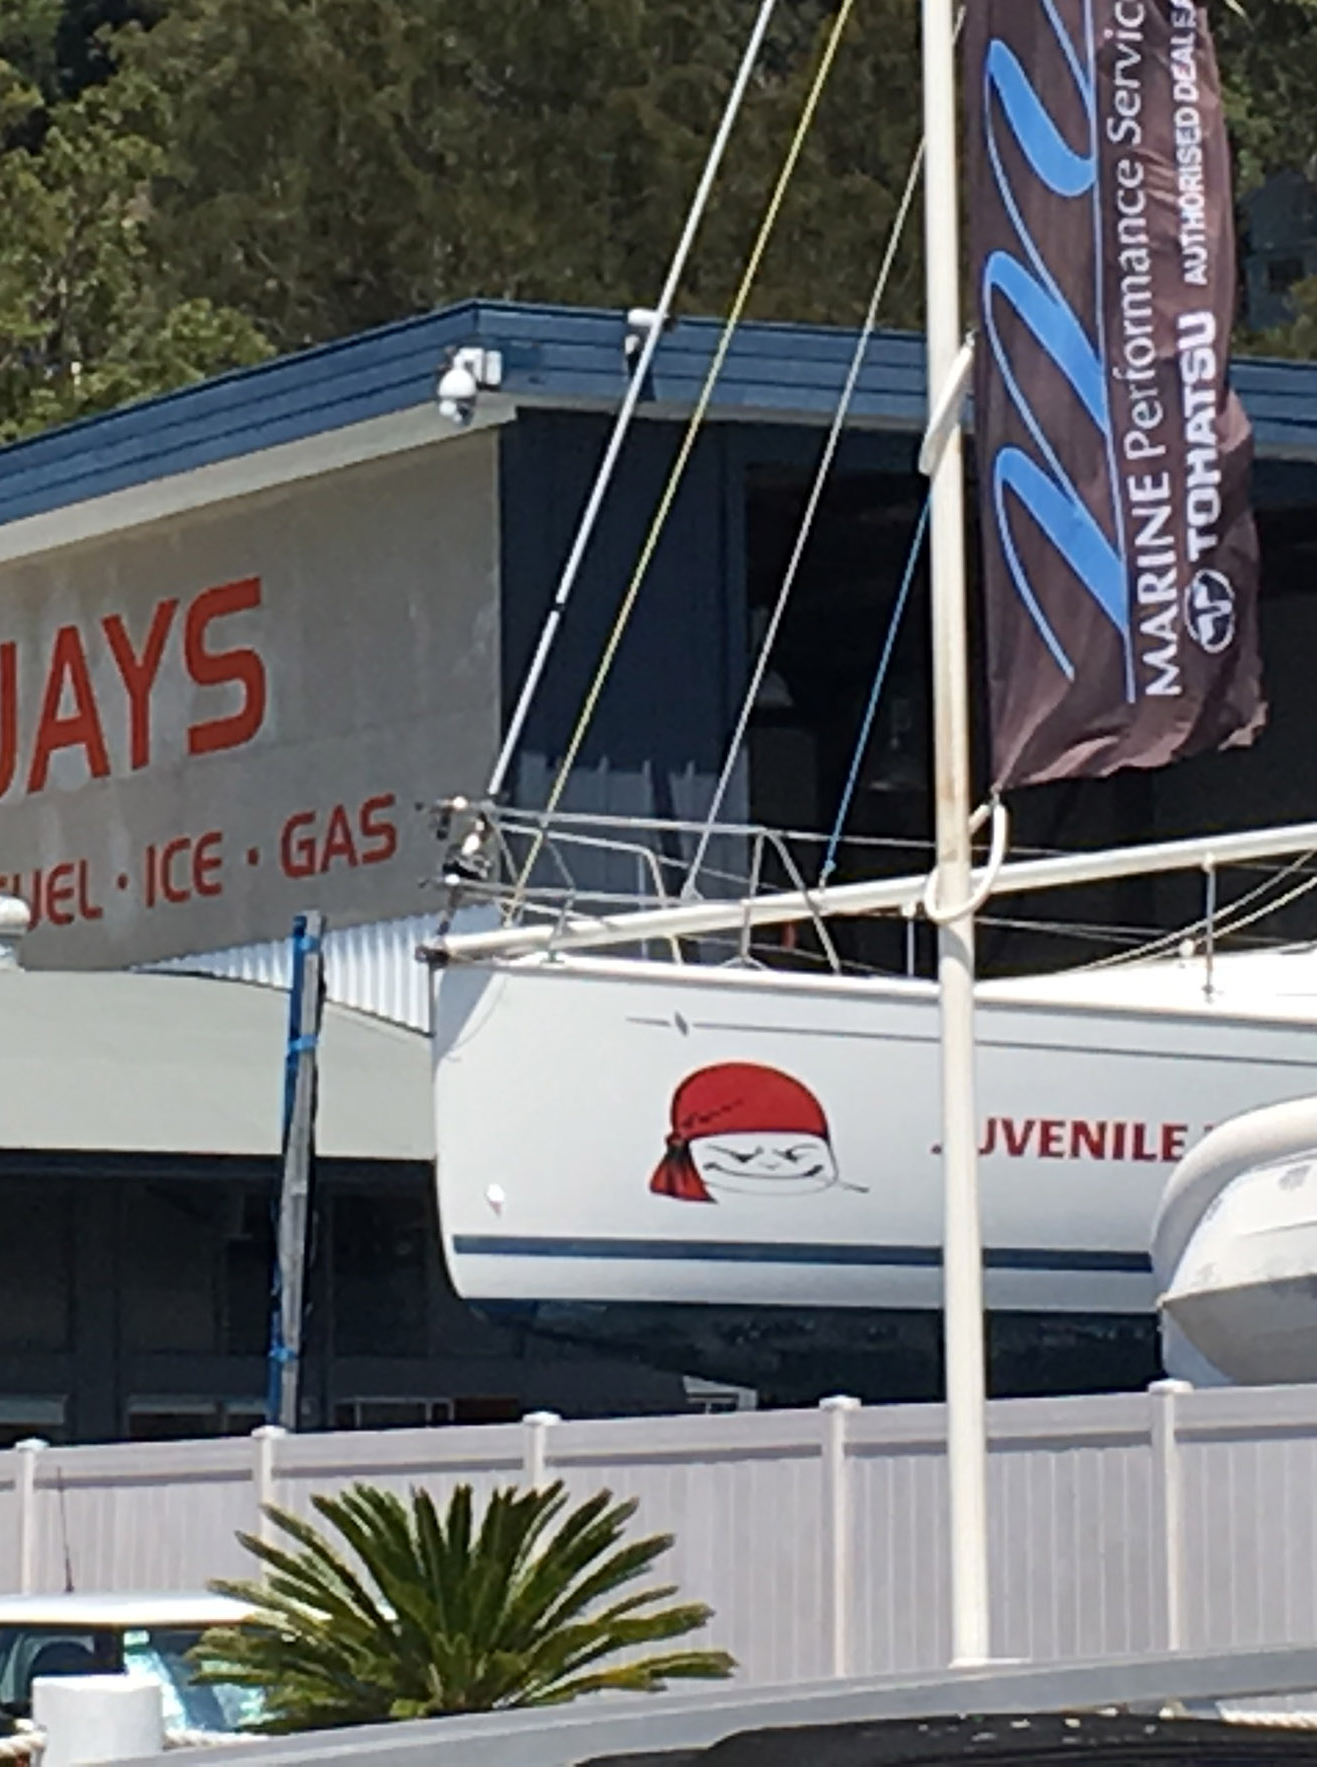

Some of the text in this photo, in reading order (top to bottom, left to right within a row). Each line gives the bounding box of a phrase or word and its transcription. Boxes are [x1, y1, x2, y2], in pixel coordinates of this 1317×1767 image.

[1174, 107, 1208, 286] AUTHORISED
[1104, 0, 1183, 696] MARINE Performance Servic
[1179, 311, 1221, 560] TOHATSU
[146, 832, 223, 908] ICE
[281, 793, 398, 880] GAS
[930, 1116, 1188, 1162] UVENILE
